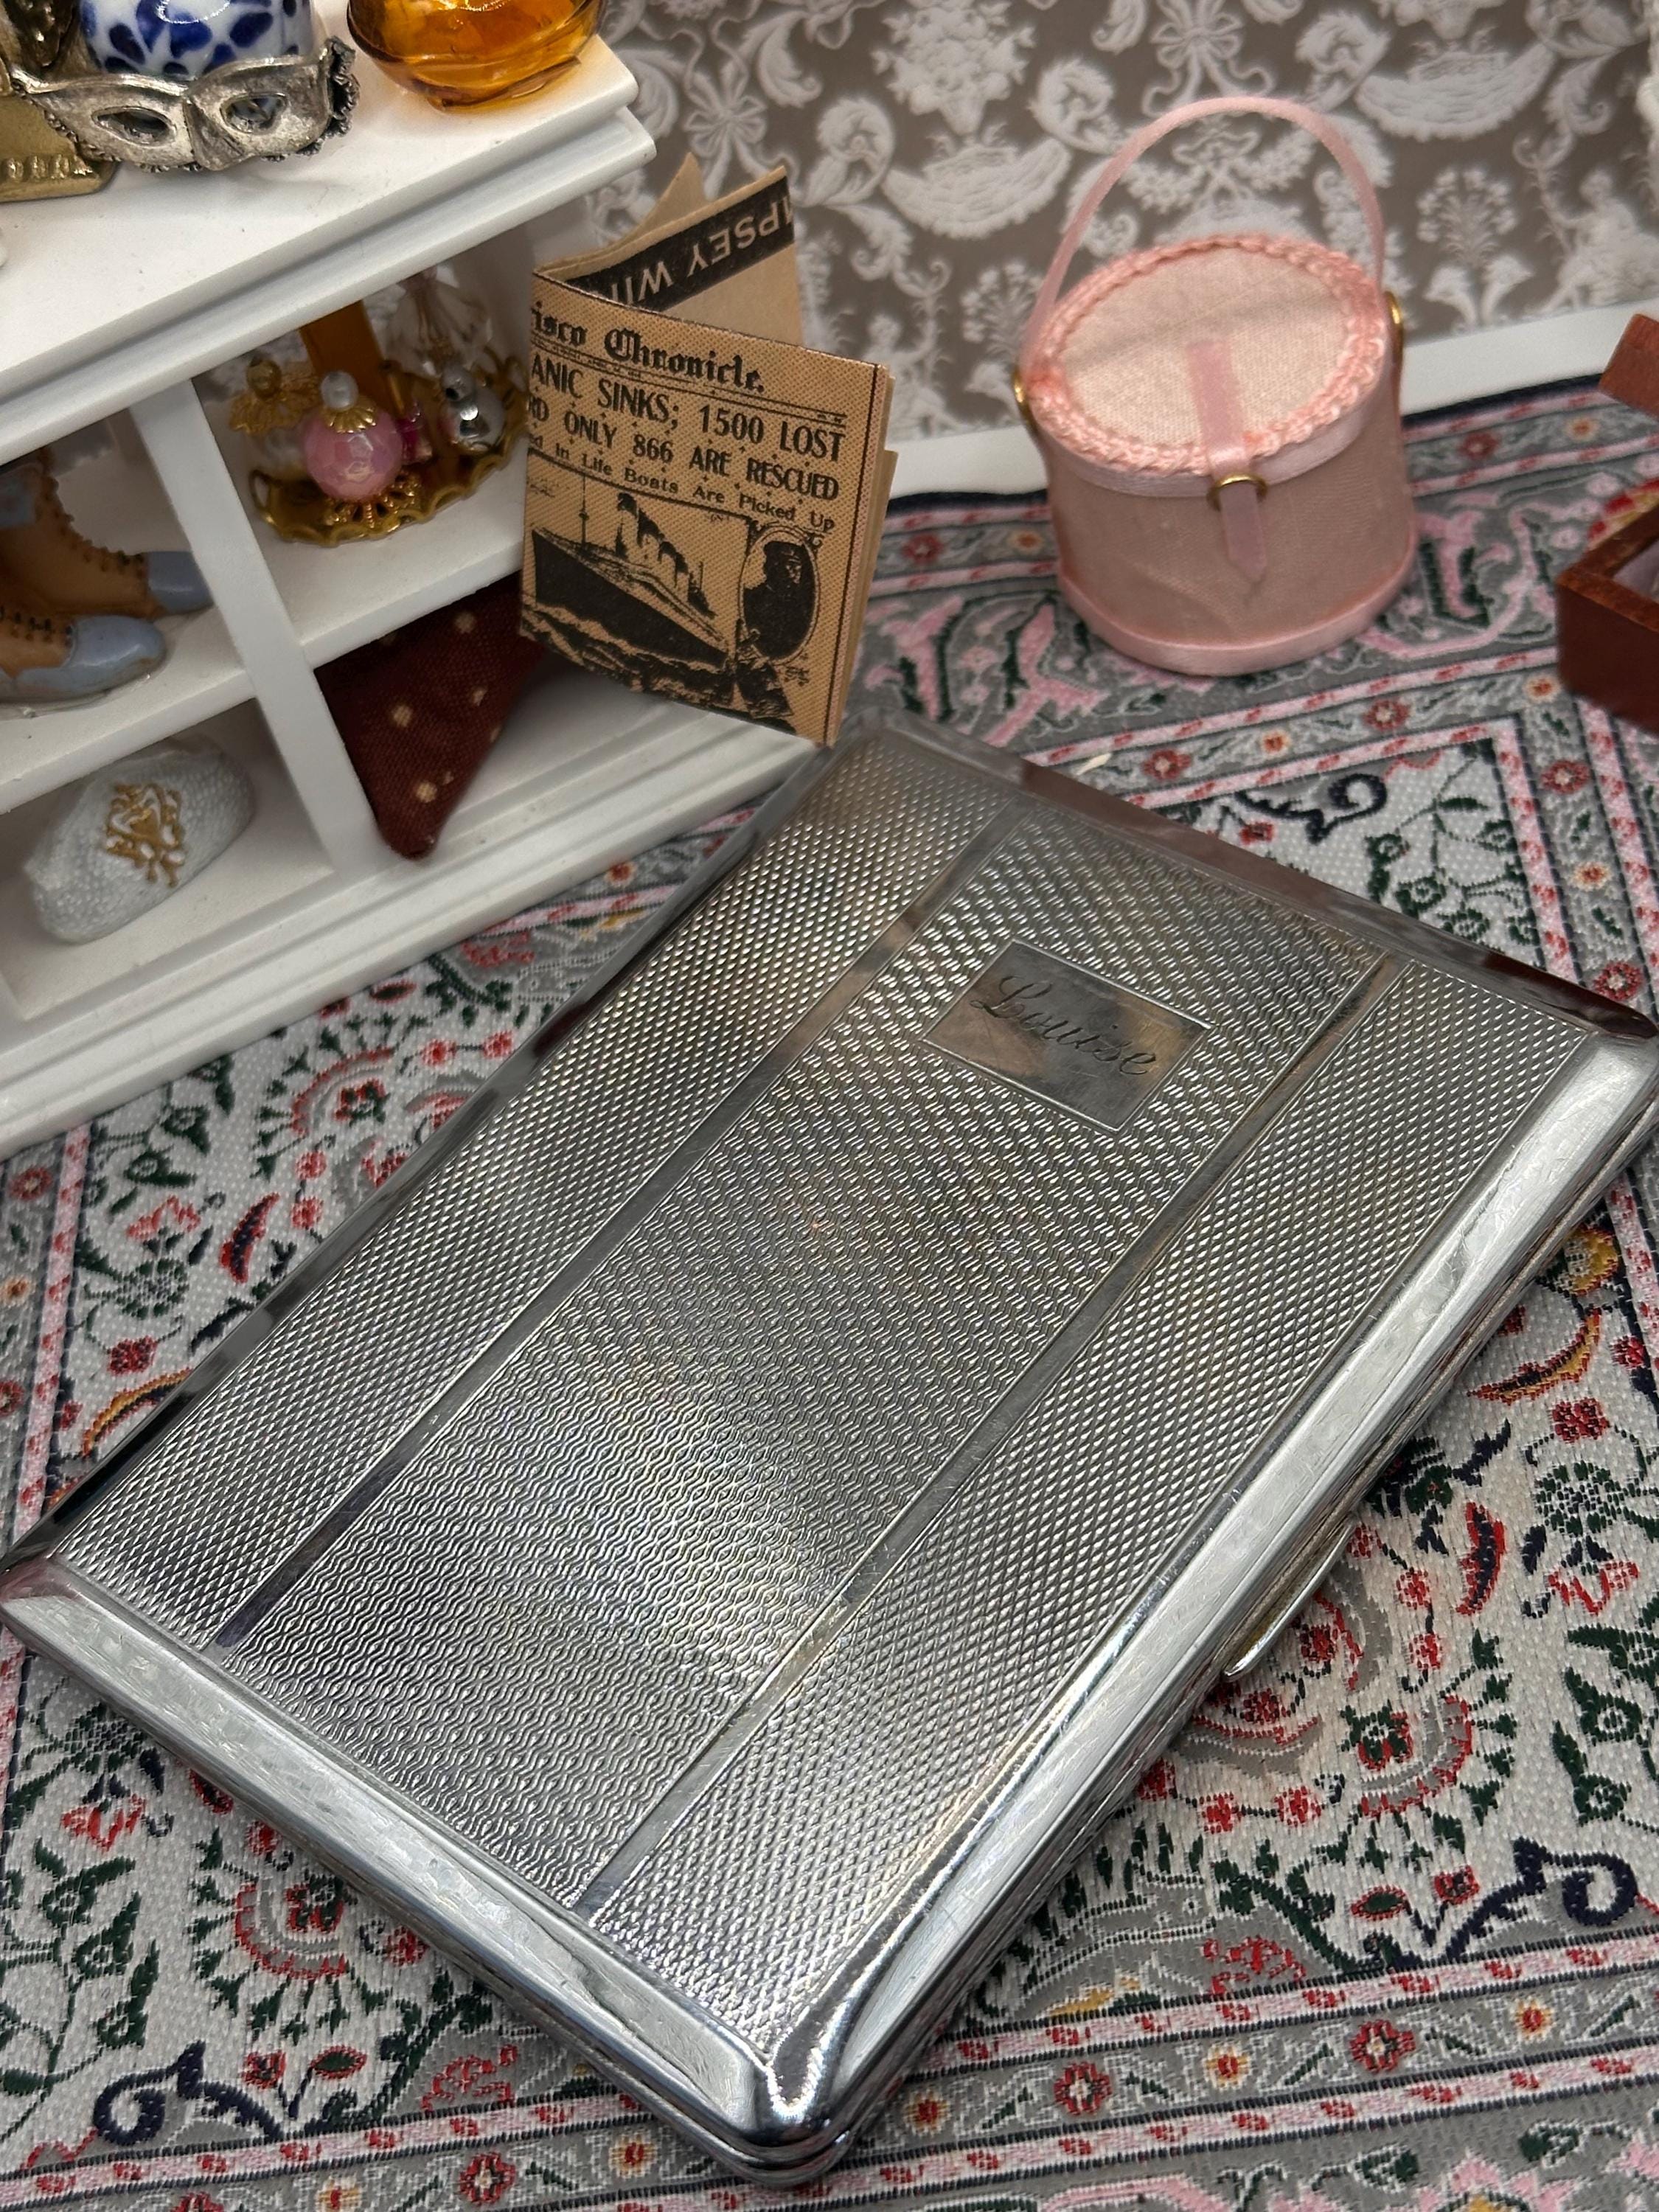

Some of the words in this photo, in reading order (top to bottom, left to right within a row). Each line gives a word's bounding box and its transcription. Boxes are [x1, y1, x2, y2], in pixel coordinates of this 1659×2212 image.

[532, 353, 584, 399] ANIC
[597, 377, 680, 431] SINKS;
[700, 403, 765, 444] 1500
[779, 420, 846, 463] LOST
[564, 411, 618, 449] ONLY
[633, 433, 674, 464] 866
[689, 445, 732, 478] ARE
[746, 456, 841, 501] RESCUED
[583, 452, 613, 476] Life
[625, 467, 680, 494] Boats
[692, 484, 726, 504] Are
[739, 493, 796, 520] Picked
[810, 510, 836, 534] Up
[970, 975, 1157, 1076] Louise
